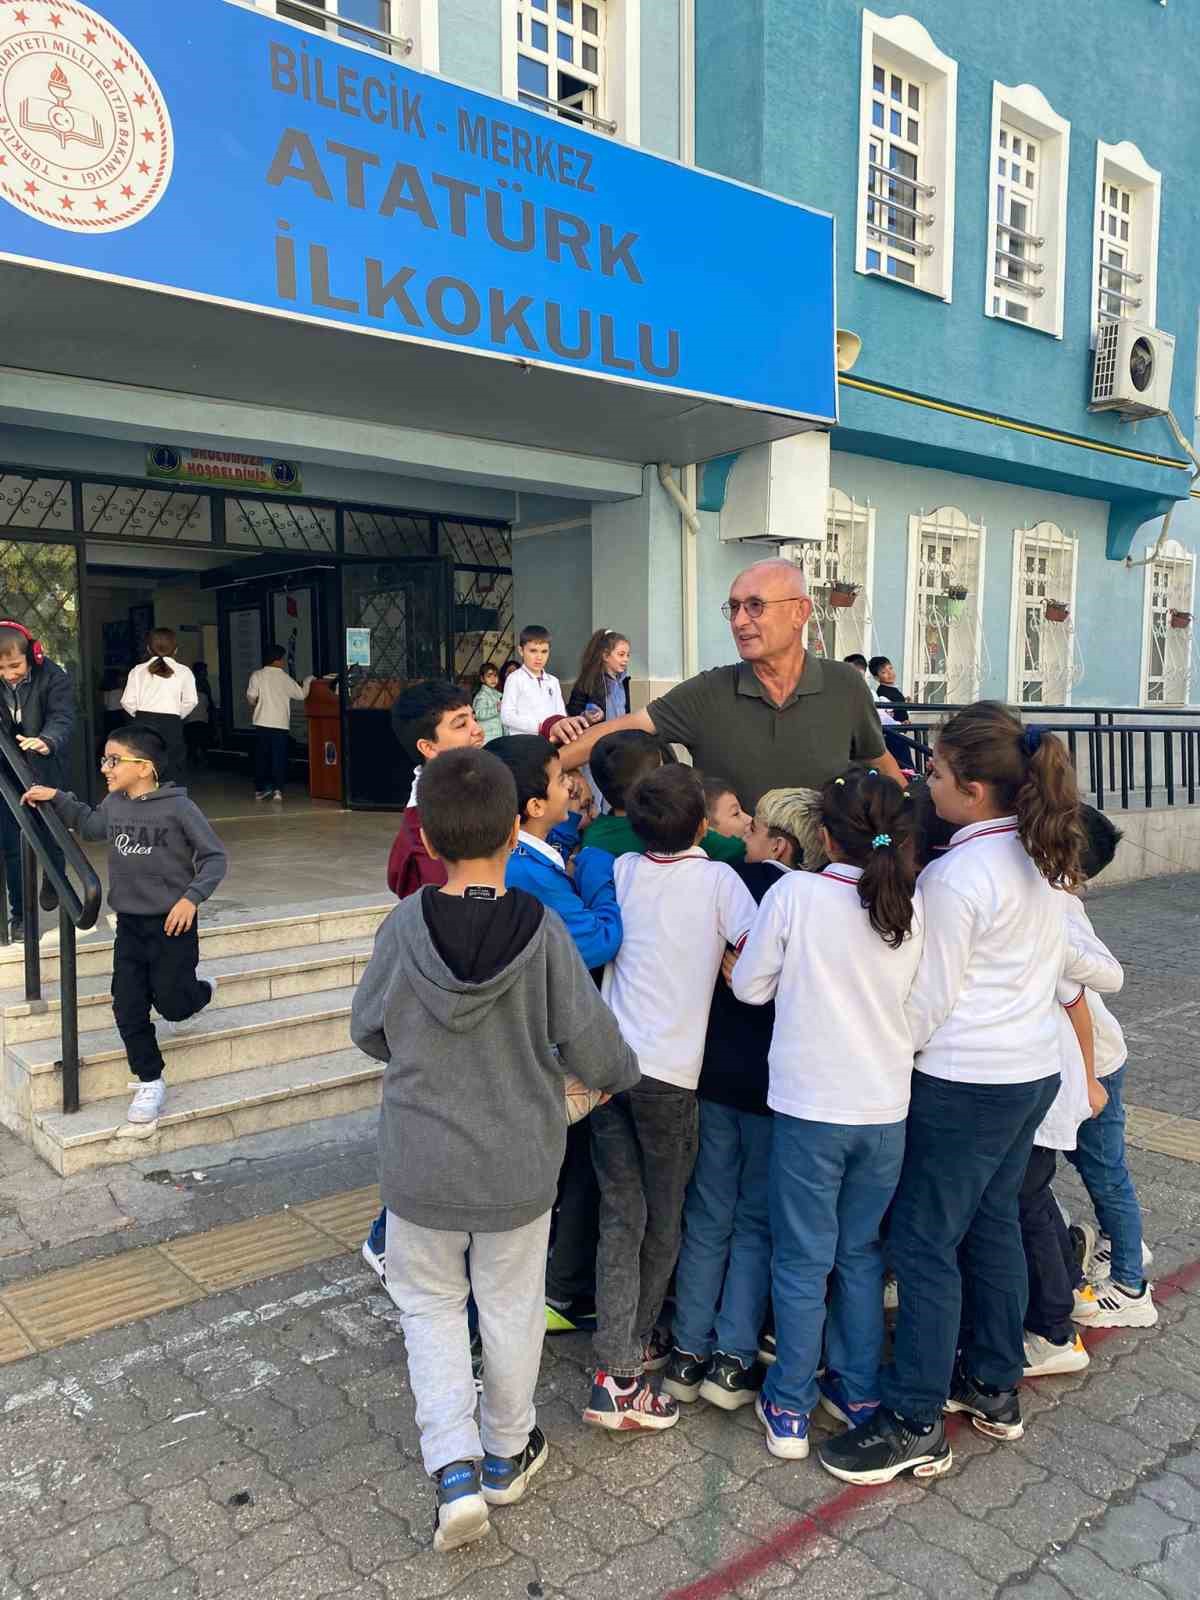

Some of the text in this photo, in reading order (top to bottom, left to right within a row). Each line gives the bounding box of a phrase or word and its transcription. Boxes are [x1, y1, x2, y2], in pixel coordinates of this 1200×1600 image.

[270, 39, 427, 140] BİLECİK
[457, 106, 596, 192] MERKEZ
[266, 127, 645, 285] ATATÜRK
[274, 218, 681, 378] İLKOKULU
[115, 833, 153, 856] Rules
